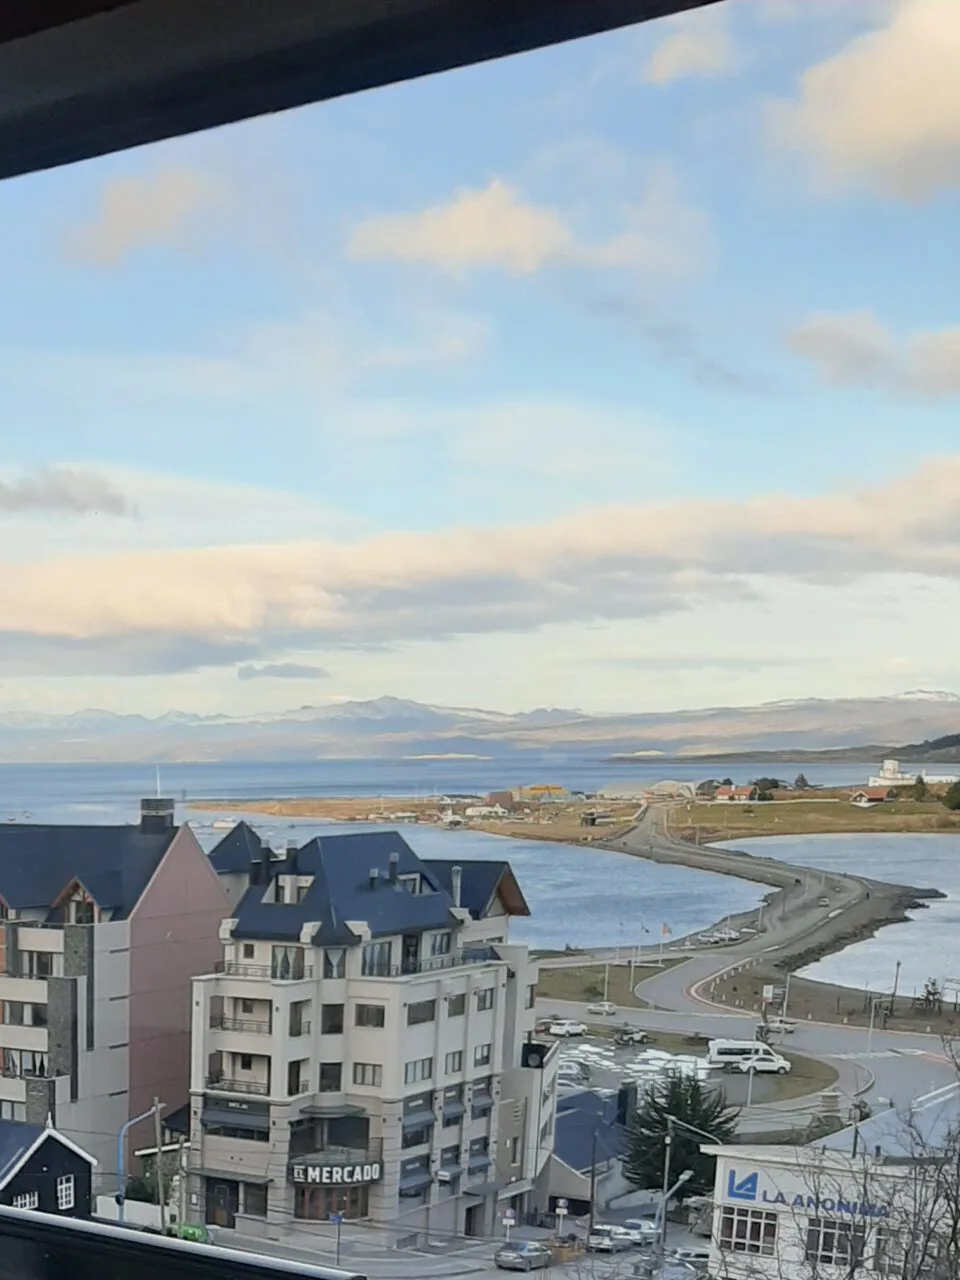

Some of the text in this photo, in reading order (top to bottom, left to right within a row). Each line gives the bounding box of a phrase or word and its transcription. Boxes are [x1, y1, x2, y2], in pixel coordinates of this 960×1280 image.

[293, 1163, 380, 1183] EL MERCADO
[762, 1190, 789, 1206] LA
